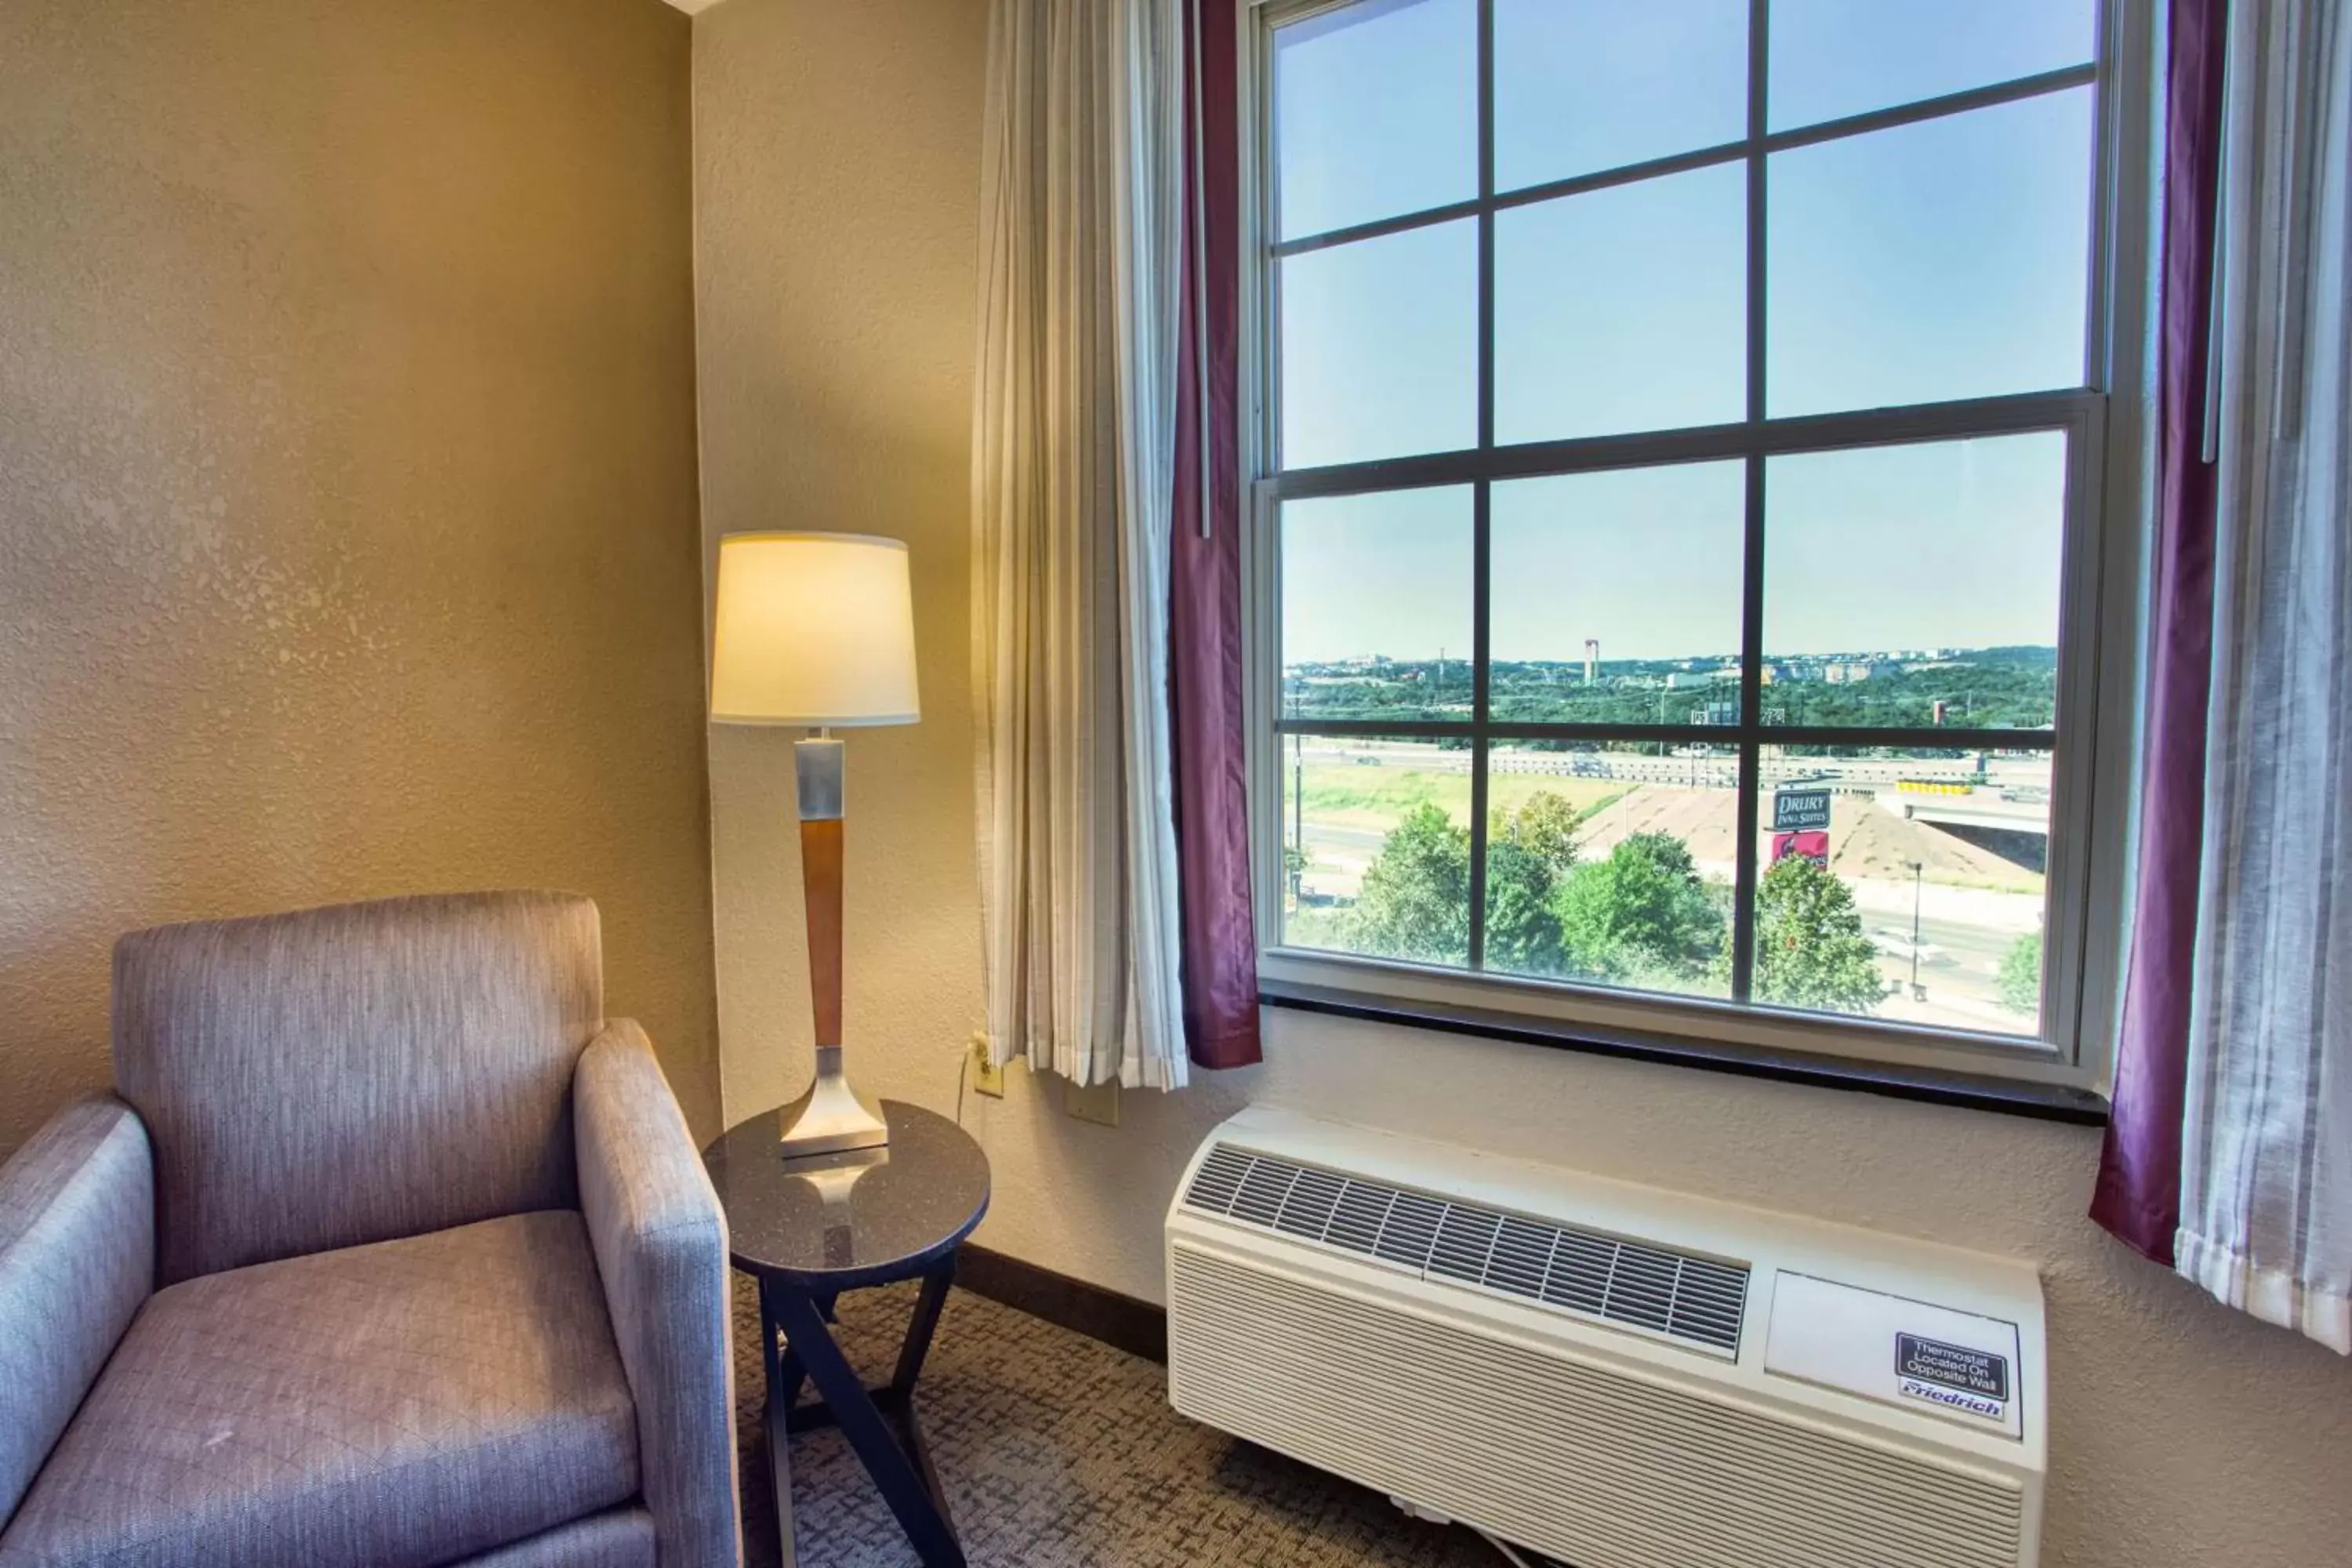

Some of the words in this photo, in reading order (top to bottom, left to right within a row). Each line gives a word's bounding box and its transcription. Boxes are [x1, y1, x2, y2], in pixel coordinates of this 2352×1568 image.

[1779, 796, 1825, 814] DRURY
[1777, 815, 1792, 825] INN
[1799, 813, 1825, 824] SUITES
[1914, 1341, 1988, 1367] Thermostat
[1915, 1351, 1966, 1373] Located
[1969, 1364, 1988, 1377] On
[1907, 1360, 1966, 1384] Opposite
[1969, 1376, 1996, 1392] Wall
[1904, 1381, 2000, 1415] Friedrich
